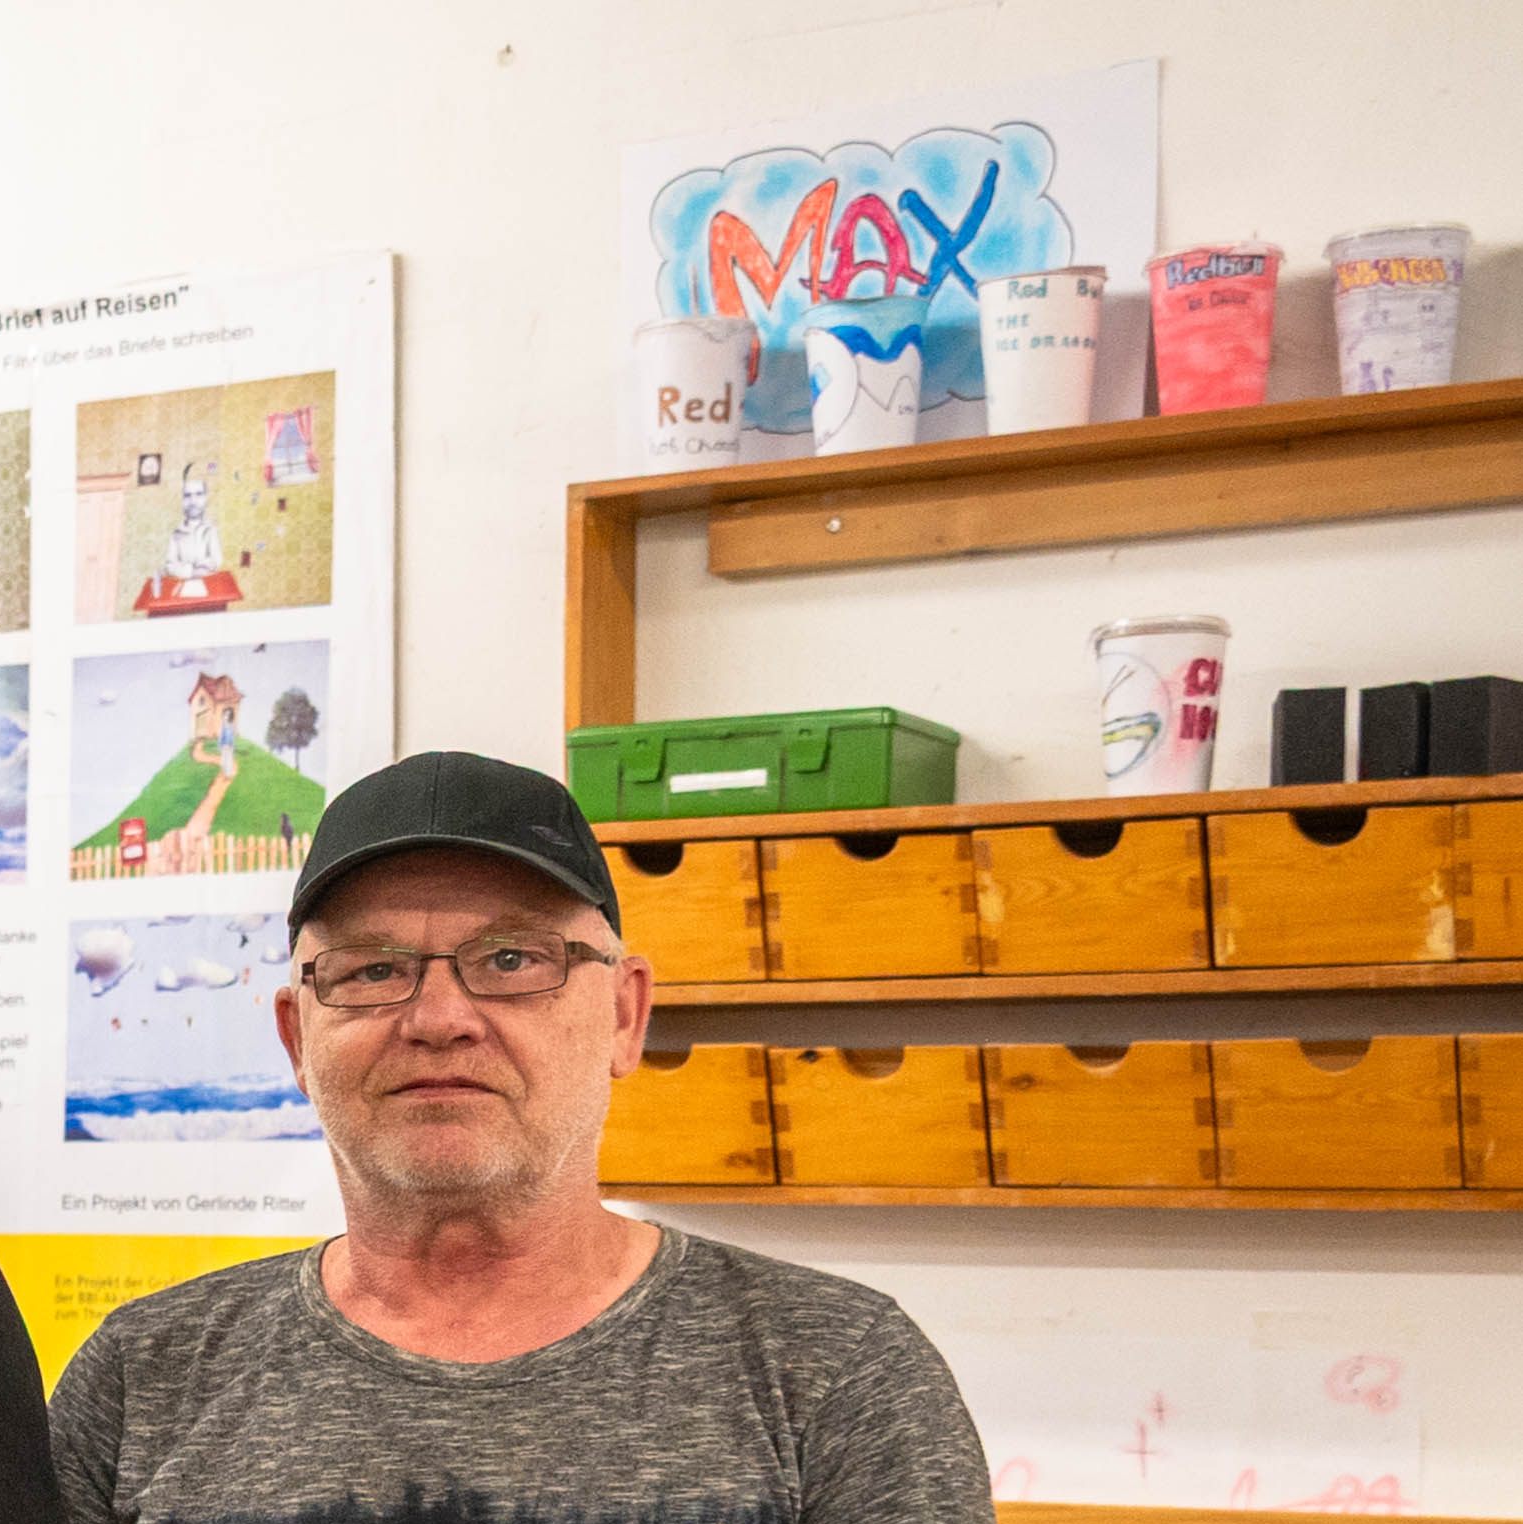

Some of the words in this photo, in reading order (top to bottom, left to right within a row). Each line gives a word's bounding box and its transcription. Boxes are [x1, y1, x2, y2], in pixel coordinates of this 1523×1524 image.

[708, 160, 1000, 383] MAX
[52, 300, 88, 326] auf
[43, 348, 78, 366] über
[84, 345, 114, 362] das
[172, 325, 254, 349] schreiben
[658, 382, 732, 428] Red
[61, 1195, 86, 1210] Ein
[92, 1195, 146, 1214] Projekt
